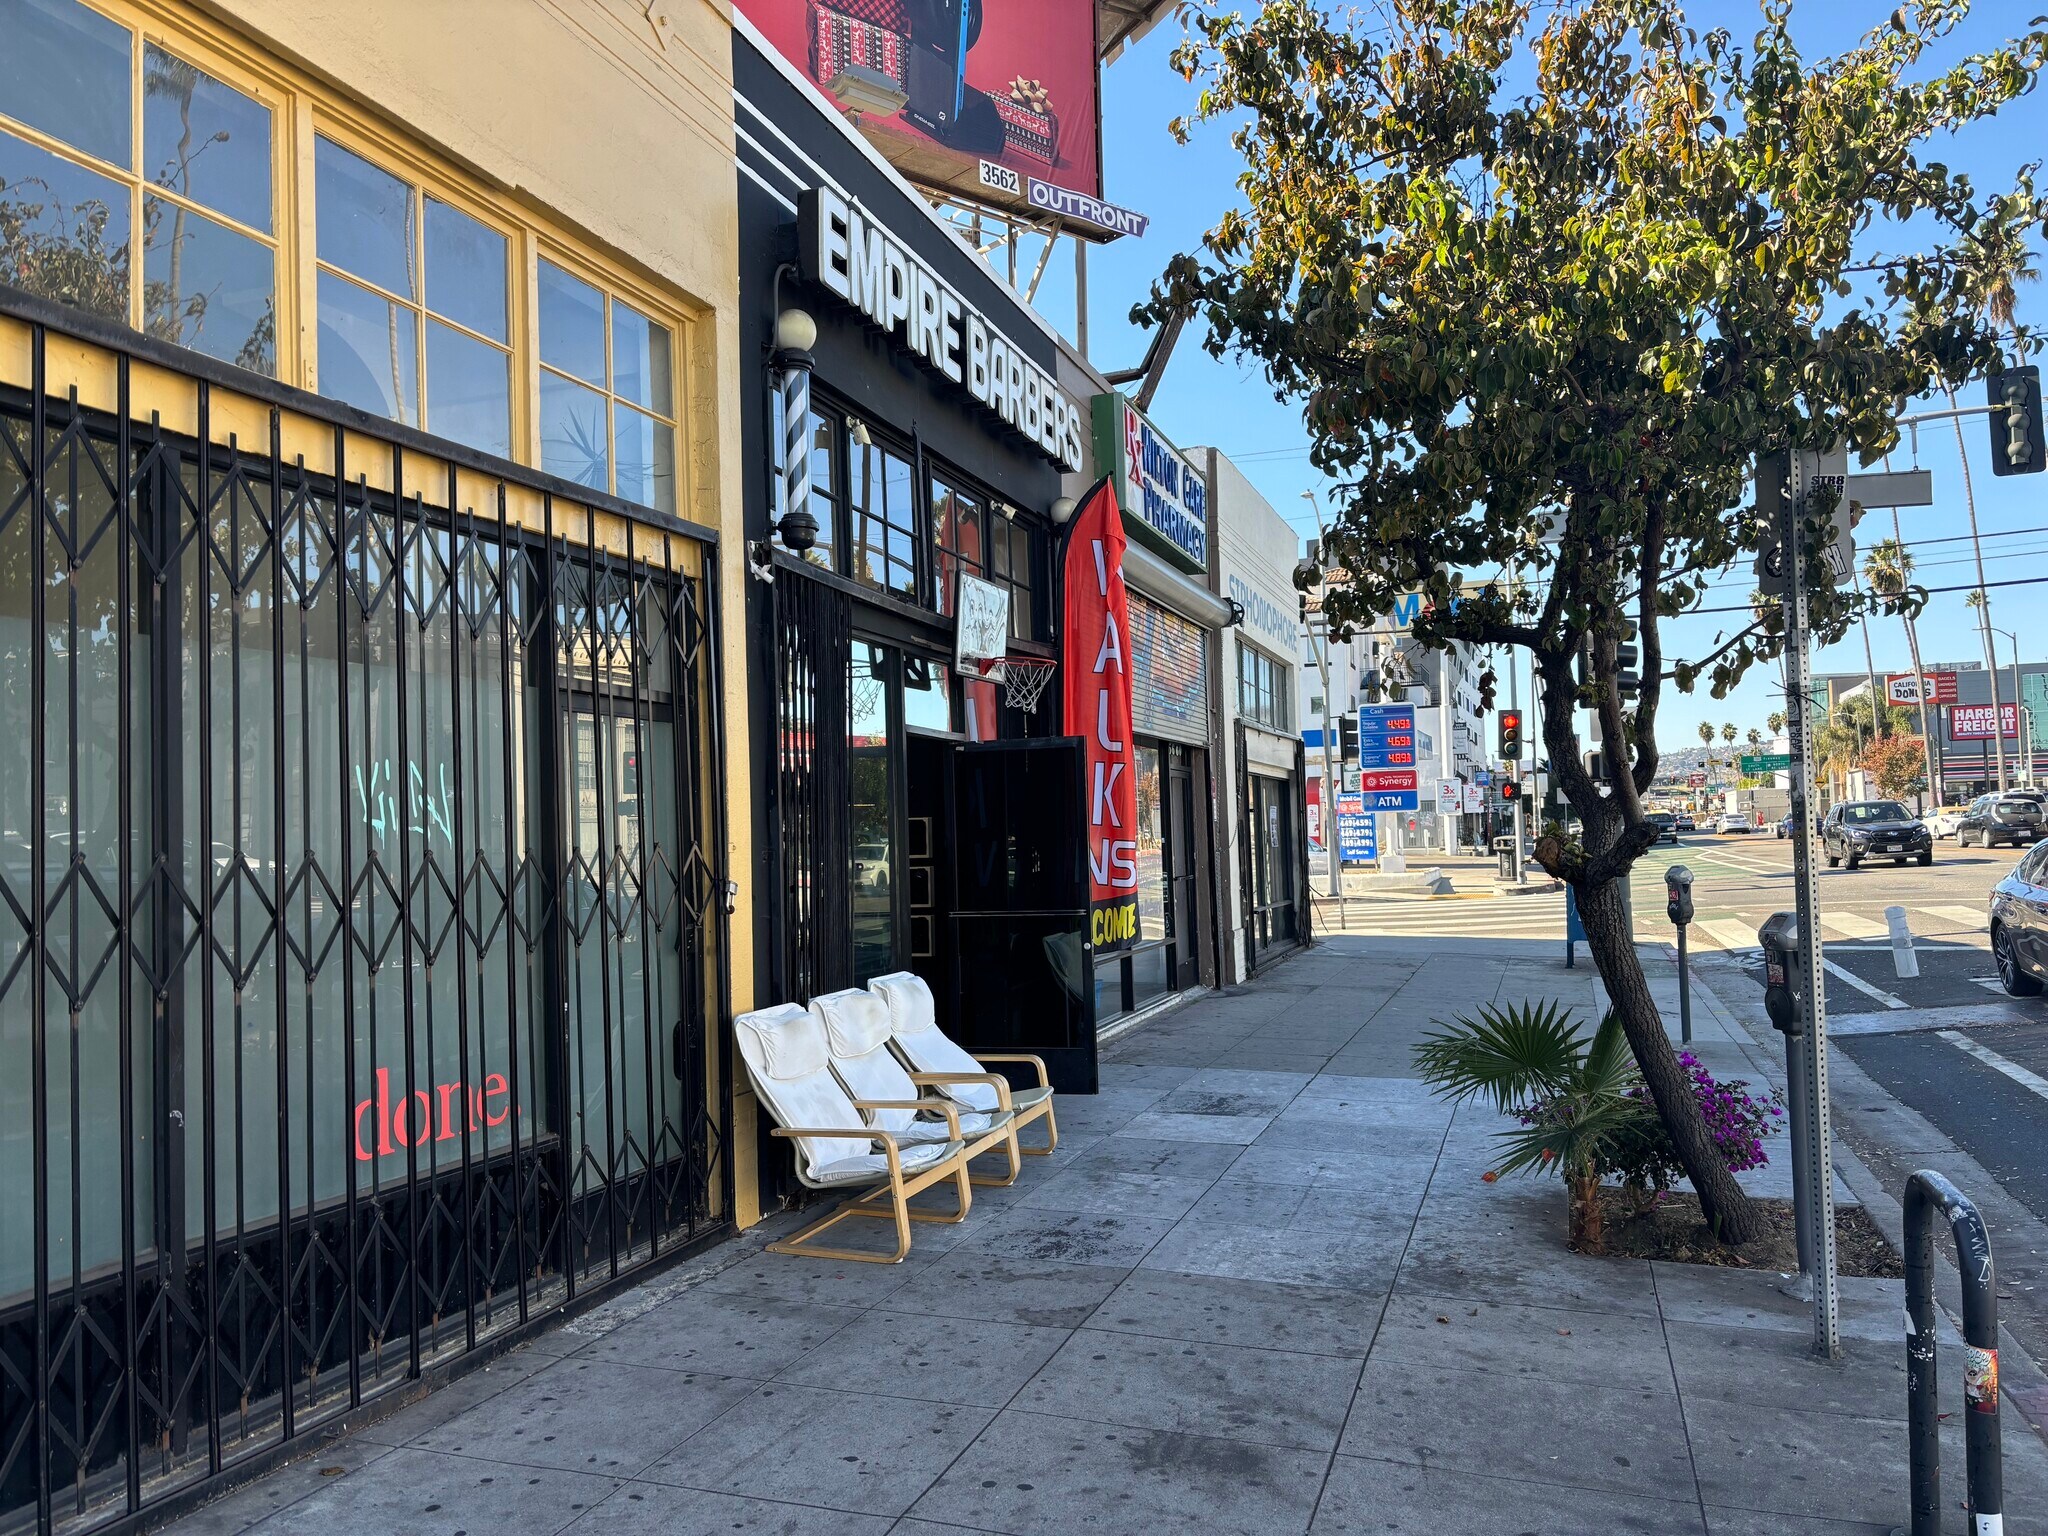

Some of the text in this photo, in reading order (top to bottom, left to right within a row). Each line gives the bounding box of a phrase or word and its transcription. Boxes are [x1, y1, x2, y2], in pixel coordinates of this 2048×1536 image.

[982, 162, 1018, 192] 3562
[1032, 183, 1143, 234] OUTFRONT
[819, 186, 1083, 473] EMPIRE BARBERS
[1141, 423, 1206, 523] WILTON CARE
[1811, 475, 1845, 485] STR8
[1143, 477, 1206, 564] PHARMACY
[1893, 680, 1932, 688] CALIFOIA
[1379, 777, 1413, 787] Synergy
[1443, 785, 1456, 794] 3x
[1378, 796, 1402, 807] ATM
[1092, 903, 1137, 947] COME
